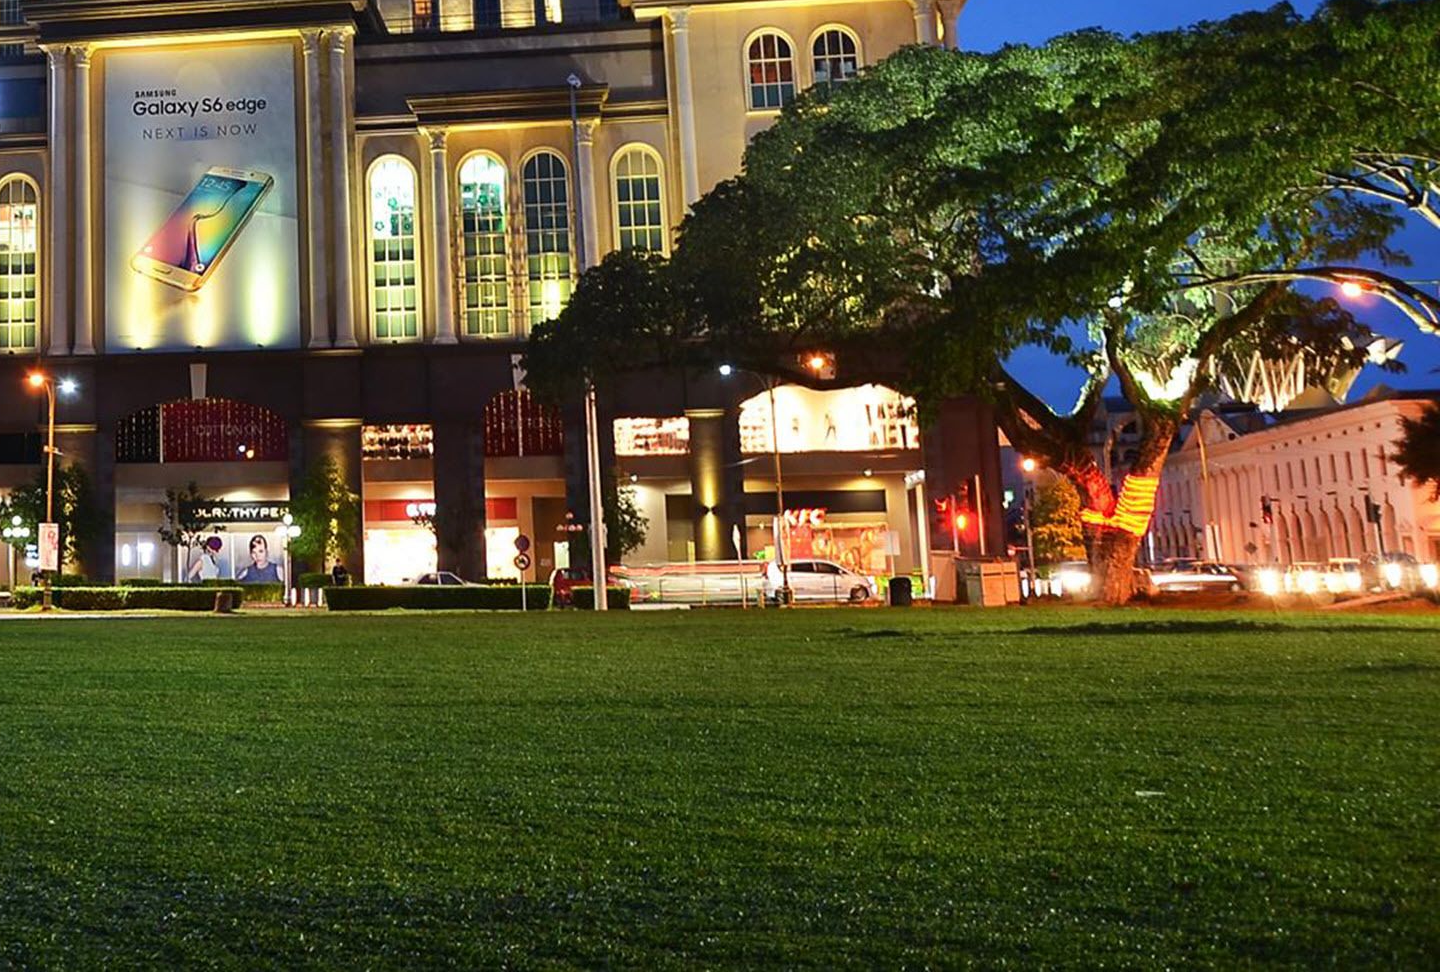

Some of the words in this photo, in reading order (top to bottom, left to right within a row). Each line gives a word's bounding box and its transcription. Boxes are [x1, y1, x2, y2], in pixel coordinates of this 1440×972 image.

[135, 89, 176, 98] SAMSUNG
[133, 100, 199, 117] Galaxy
[202, 97, 223, 112] S6
[226, 98, 266, 114] edge
[143, 127, 185, 140] NEXT
[193, 126, 208, 138] IS
[217, 124, 257, 137] NOW
[783, 508, 827, 526] KFC
